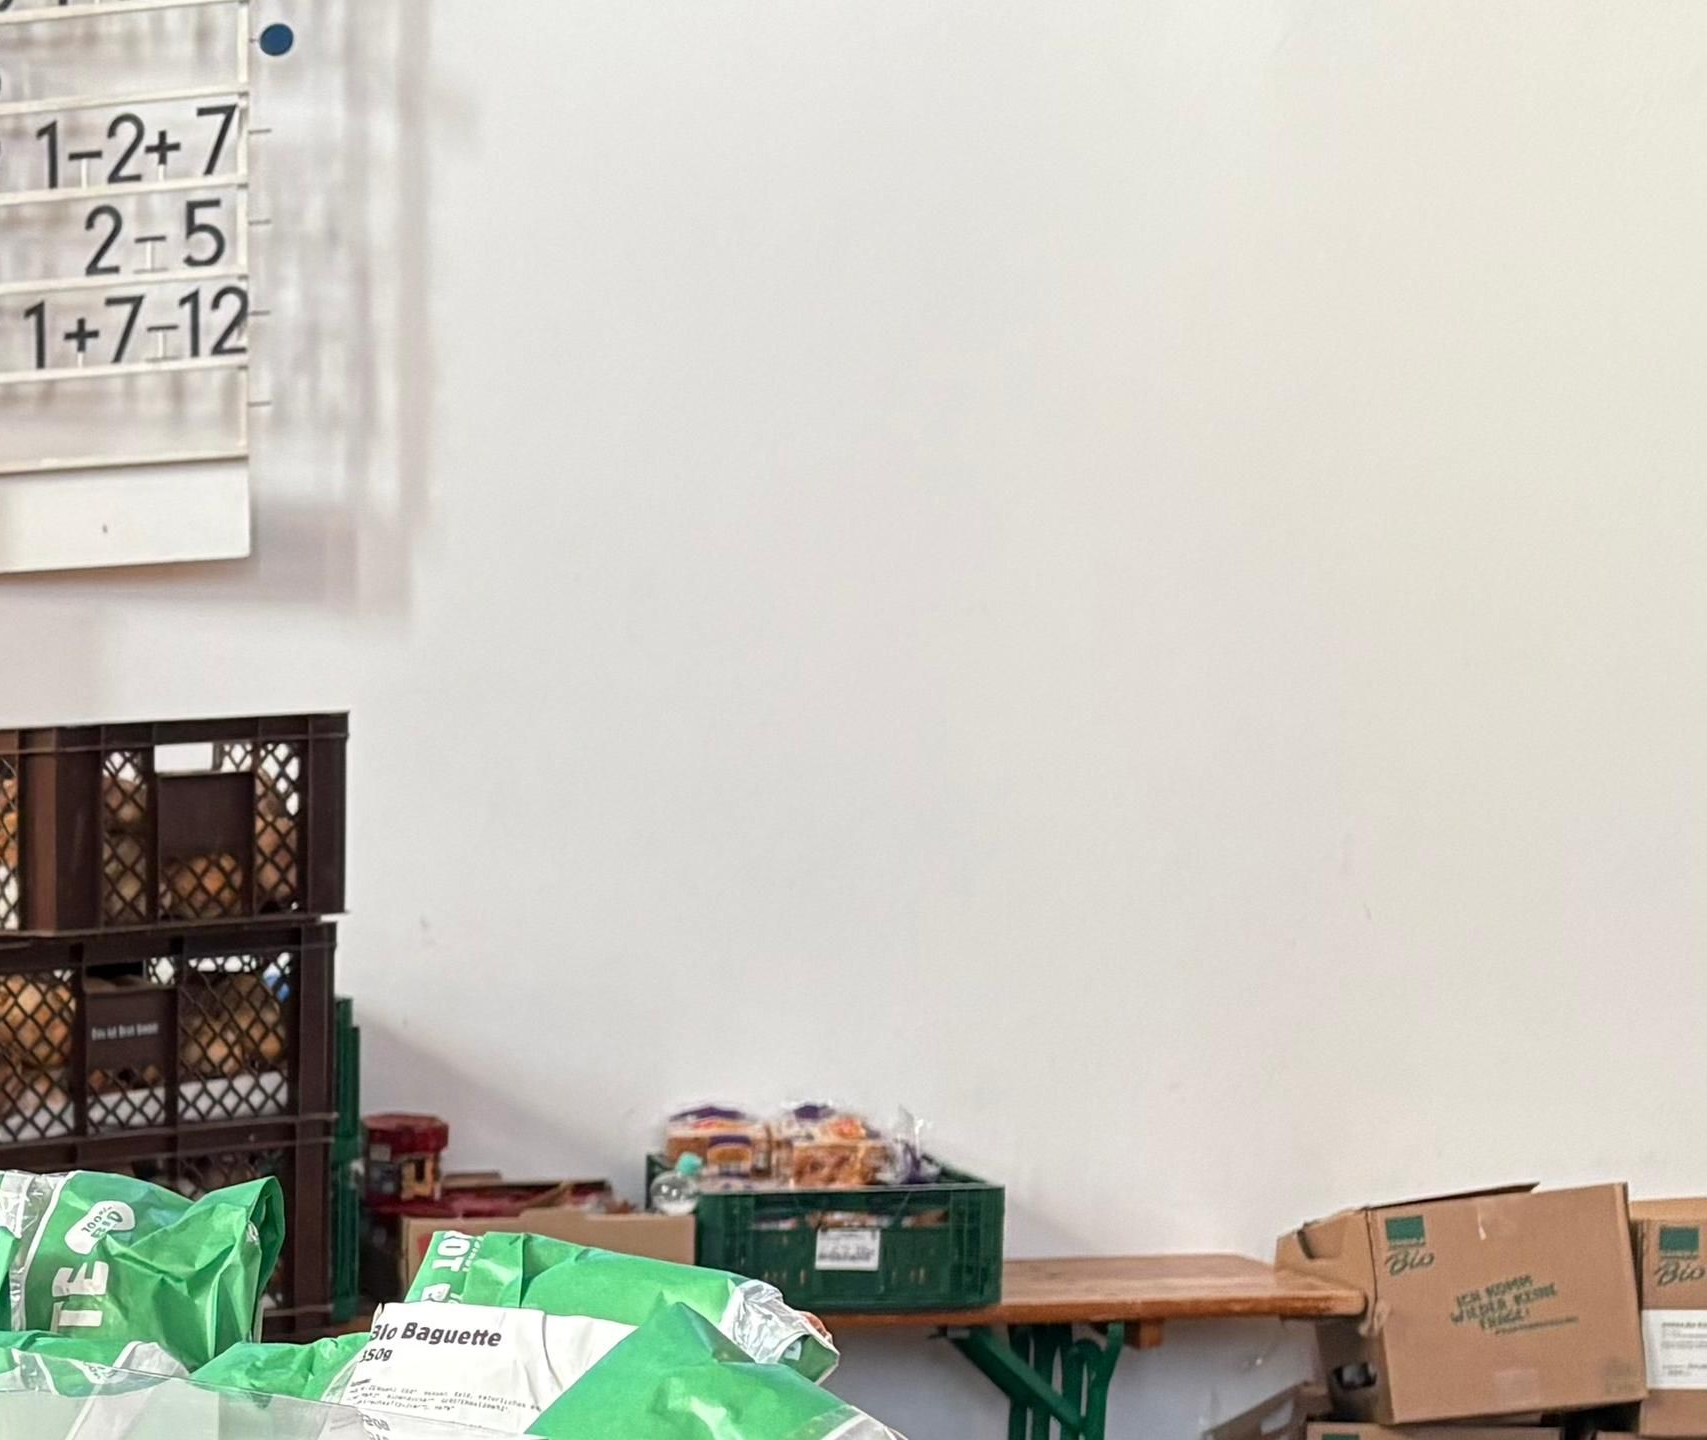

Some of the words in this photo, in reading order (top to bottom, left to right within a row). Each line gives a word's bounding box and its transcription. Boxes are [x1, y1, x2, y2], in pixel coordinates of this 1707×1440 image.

[1385, 1251, 1435, 1276] Bio
[1655, 1260, 1705, 1287] Bio
[400, 1322, 502, 1347] Baguette
